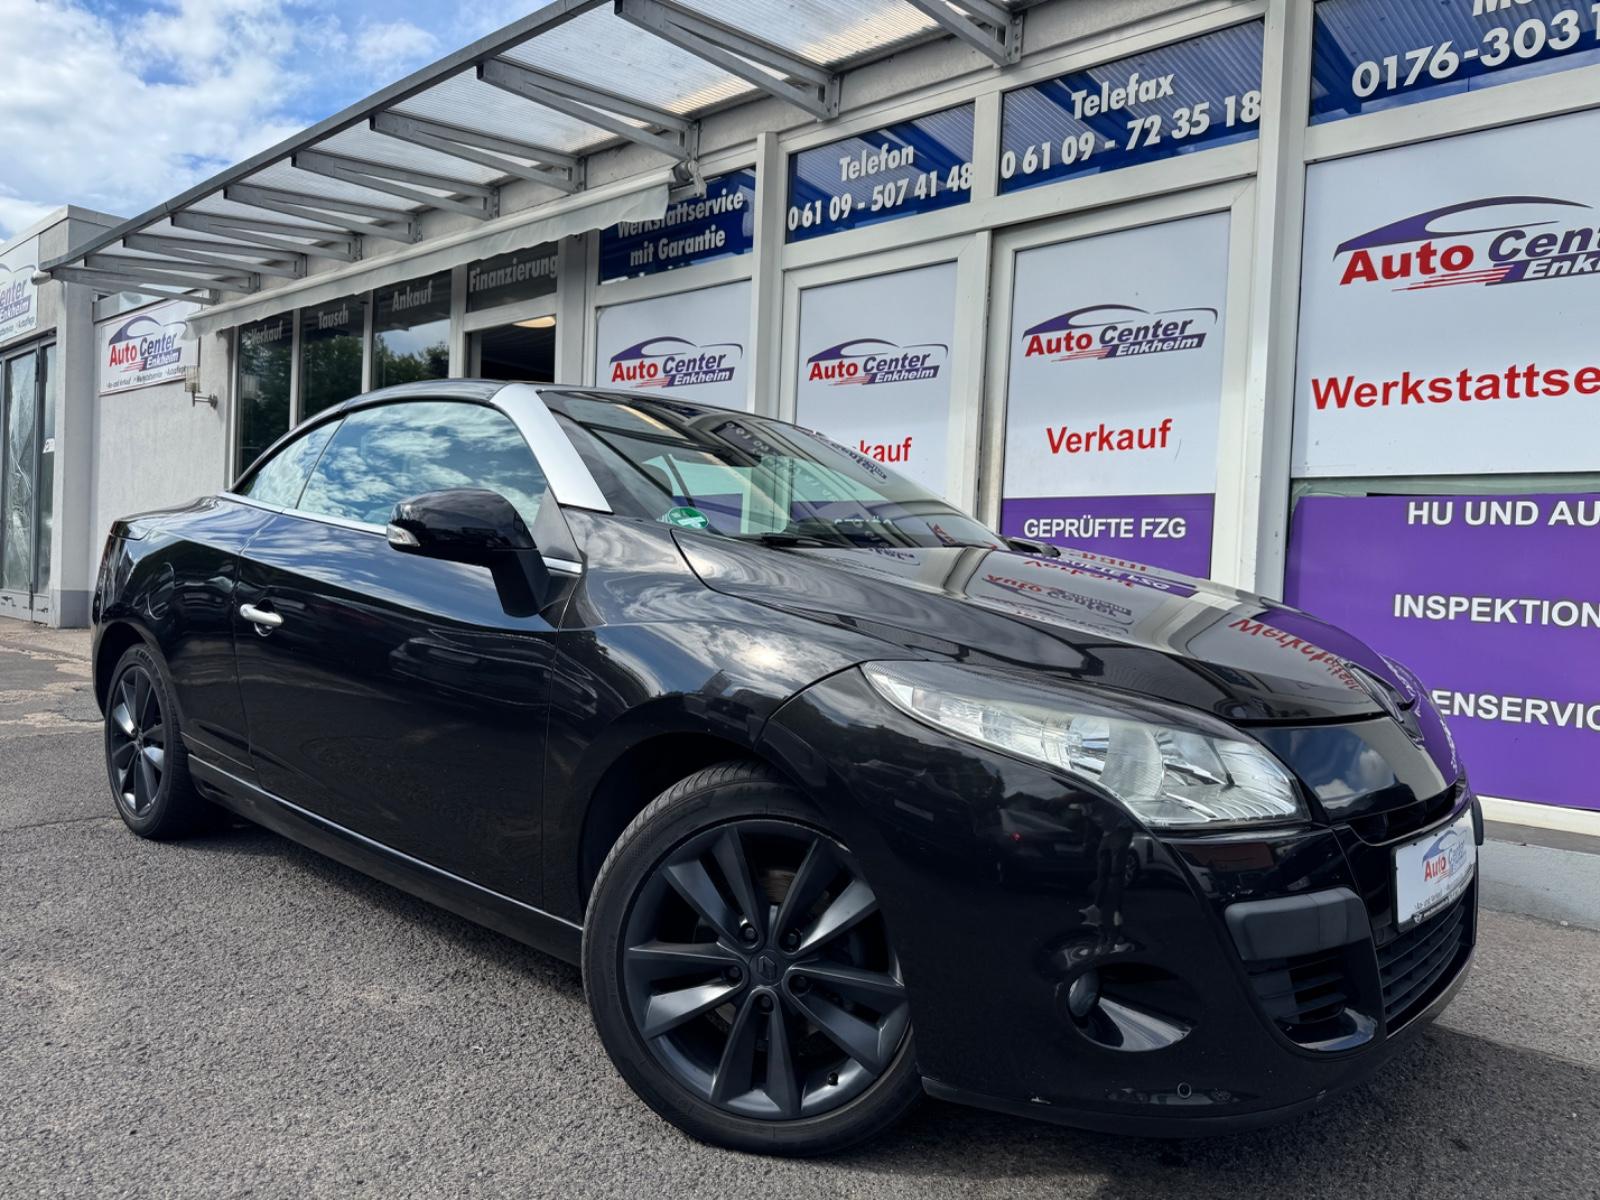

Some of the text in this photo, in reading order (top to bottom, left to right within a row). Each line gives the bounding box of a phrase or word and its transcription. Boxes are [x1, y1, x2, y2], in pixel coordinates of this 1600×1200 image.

[1071, 73, 1175, 120] Telefax
[1001, 151, 1016, 179] 0
[1022, 143, 1051, 174] 61
[1061, 131, 1096, 165] 09
[1125, 115, 1161, 151] 72
[1172, 102, 1210, 139] 35
[1224, 90, 1261, 127] 18
[839, 143, 914, 182] Telefon
[788, 206, 798, 231] 0
[802, 200, 822, 228] 61
[829, 193, 852, 221] 09
[871, 178, 910, 212] 507
[914, 171, 938, 200] 41
[947, 162, 974, 193] 48
[630, 224, 726, 267] mit Garantie
[1339, 227, 1600, 286] Auto Cen
[469, 255, 559, 293] Finanzierung
[1523, 253, 1600, 280] Enk
[392, 279, 433, 312] Ankauf
[318, 303, 349, 329] Tausch
[109, 332, 178, 368] Auto Center
[1025, 319, 1194, 358] Auto Center
[1115, 336, 1199, 357] Enkheim
[611, 352, 727, 383] Auto Center
[673, 370, 731, 386] Enkheim
[809, 352, 931, 381] Auto Center
[874, 368, 935, 384] Enkheim
[1311, 363, 1600, 410] Werkstattse
[852, 436, 912, 463] kauf
[1046, 418, 1173, 455] Verkauf
[1023, 515, 1187, 539] GEPRÜFTE FZG
[1407, 501, 1600, 527] HU UND AU
[1393, 594, 1600, 629] INSPEKTION
[1424, 856, 1447, 882] Auto
